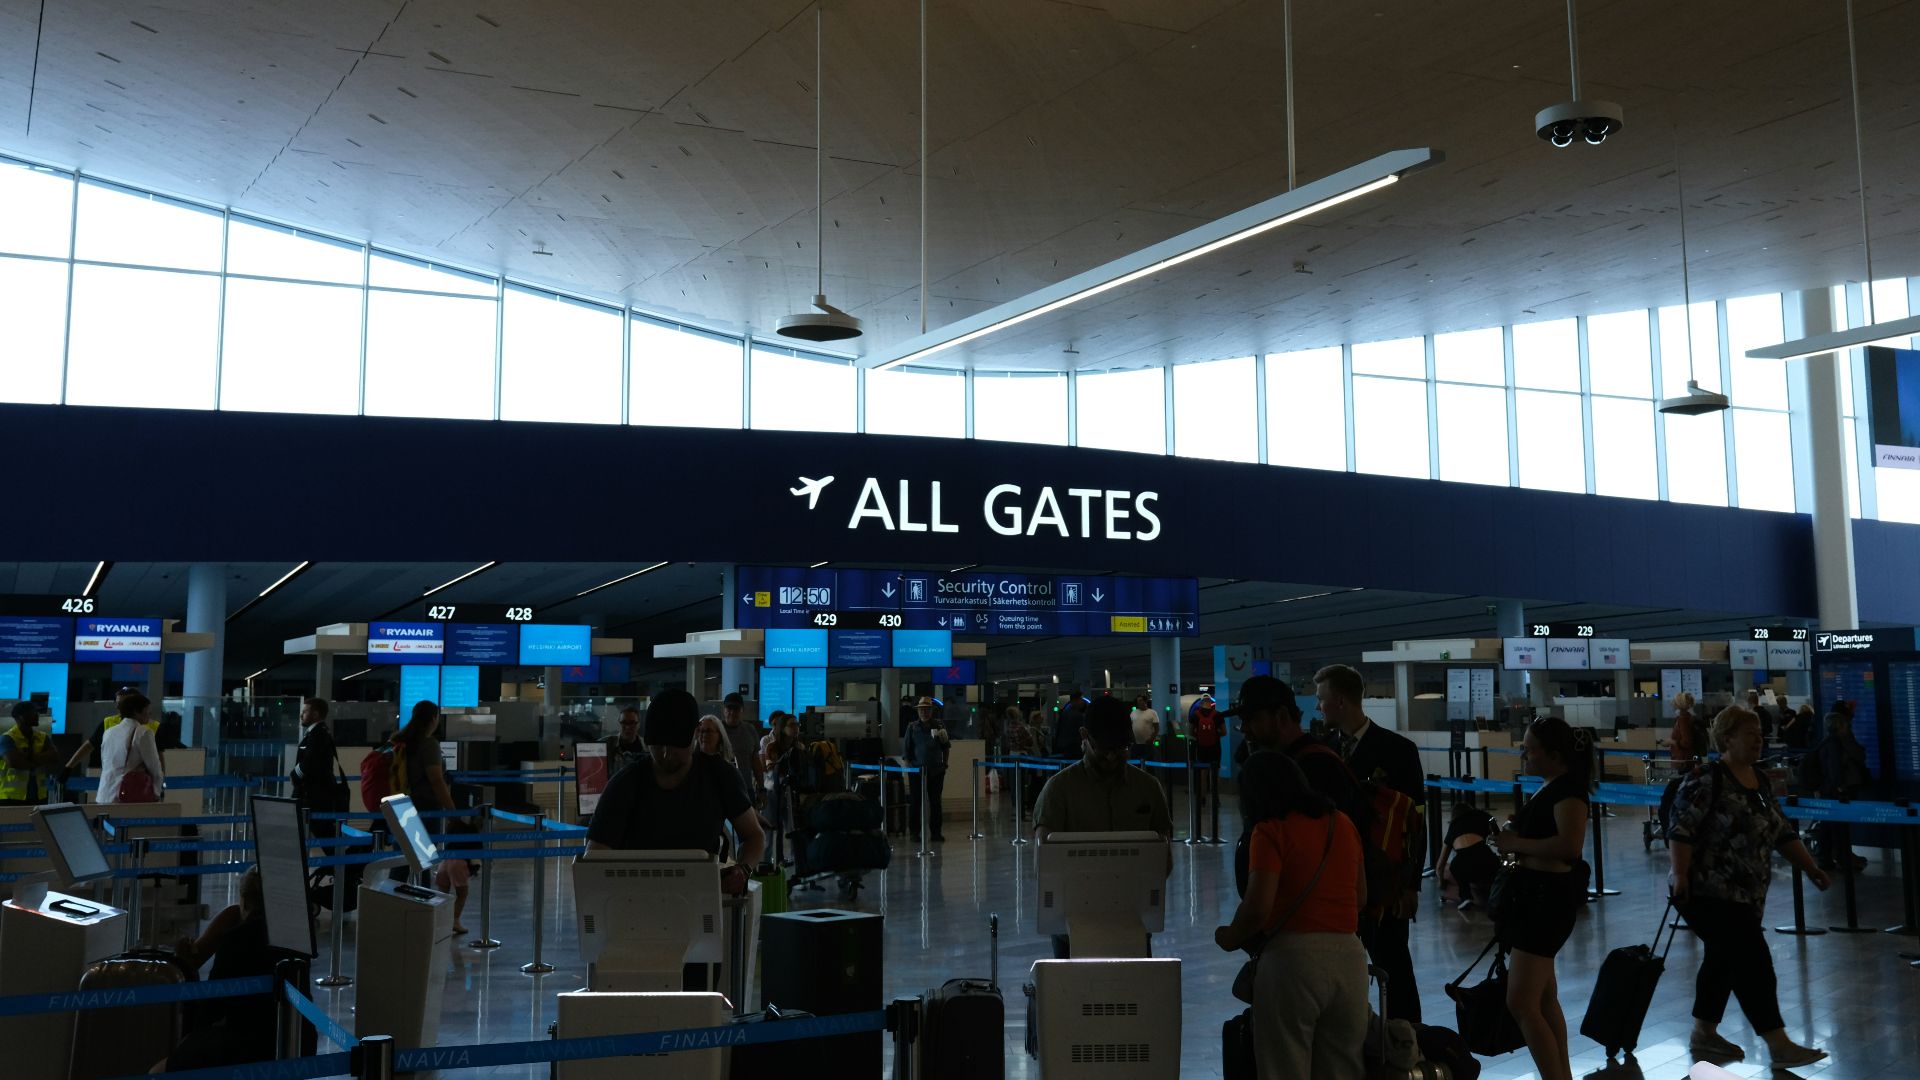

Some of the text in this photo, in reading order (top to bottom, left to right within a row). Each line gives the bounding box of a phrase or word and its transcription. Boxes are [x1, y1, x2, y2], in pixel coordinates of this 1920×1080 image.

[1882, 454, 1916, 462] FINNAIR
[848, 477, 1161, 541] ALL GATES
[938, 578, 1052, 598] Security Control
[780, 587, 830, 605] 12:50
[934, 596, 1056, 606] Turvatarkastus Säkerhetskontroll
[62, 598, 94, 612] 426
[428, 606, 456, 620] 427
[506, 608, 532, 620] 428
[976, 614, 988, 623] 0-5
[814, 614, 837, 626] 429
[878, 615, 902, 627] 430
[999, 616, 1024, 624] Queuing
[96, 624, 150, 633] RYANAIR
[386, 628, 434, 636] RYANAIR
[1533, 625, 1550, 636] 230
[1578, 626, 1594, 636] 229
[1754, 629, 1768, 638] 228
[1792, 630, 1806, 640] 227
[1832, 634, 1874, 644] Departures
[154, 842, 198, 850] FINAVIA
[48, 990, 136, 1009] FINAVIA
[659, 1028, 747, 1050] FINAVIA
[398, 1050, 470, 1068] NAVIA
